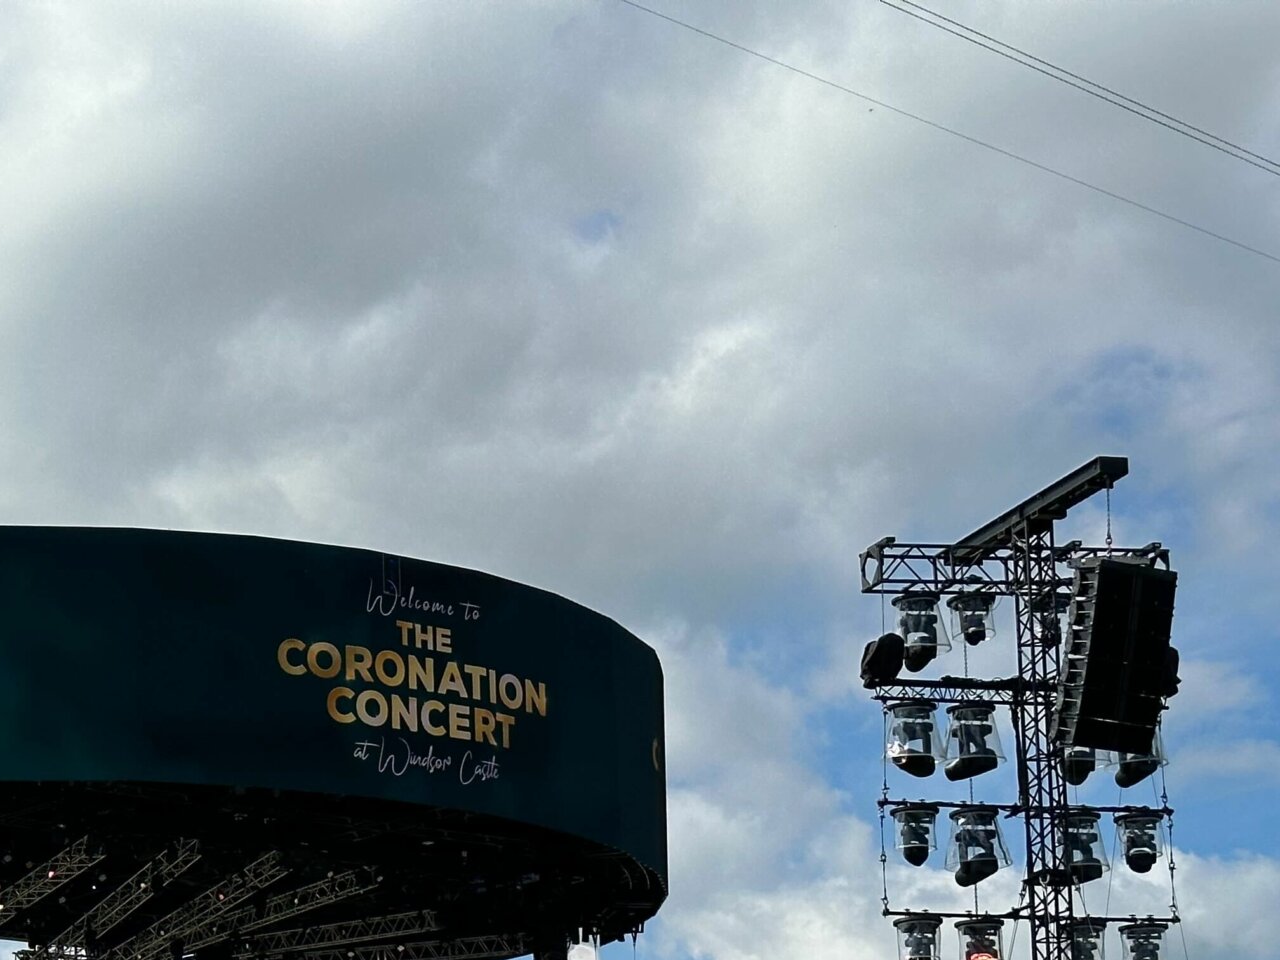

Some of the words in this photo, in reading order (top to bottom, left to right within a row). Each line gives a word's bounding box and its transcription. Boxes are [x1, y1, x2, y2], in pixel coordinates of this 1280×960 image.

[366, 577, 454, 617] Welcome
[459, 601, 481, 621] to
[396, 619, 452, 654] THE
[277, 638, 547, 717] CORONATION
[326, 686, 516, 749] CONCERT
[353, 741, 380, 762] at
[376, 736, 452, 777] Windsor
[459, 749, 500, 786] Castle
